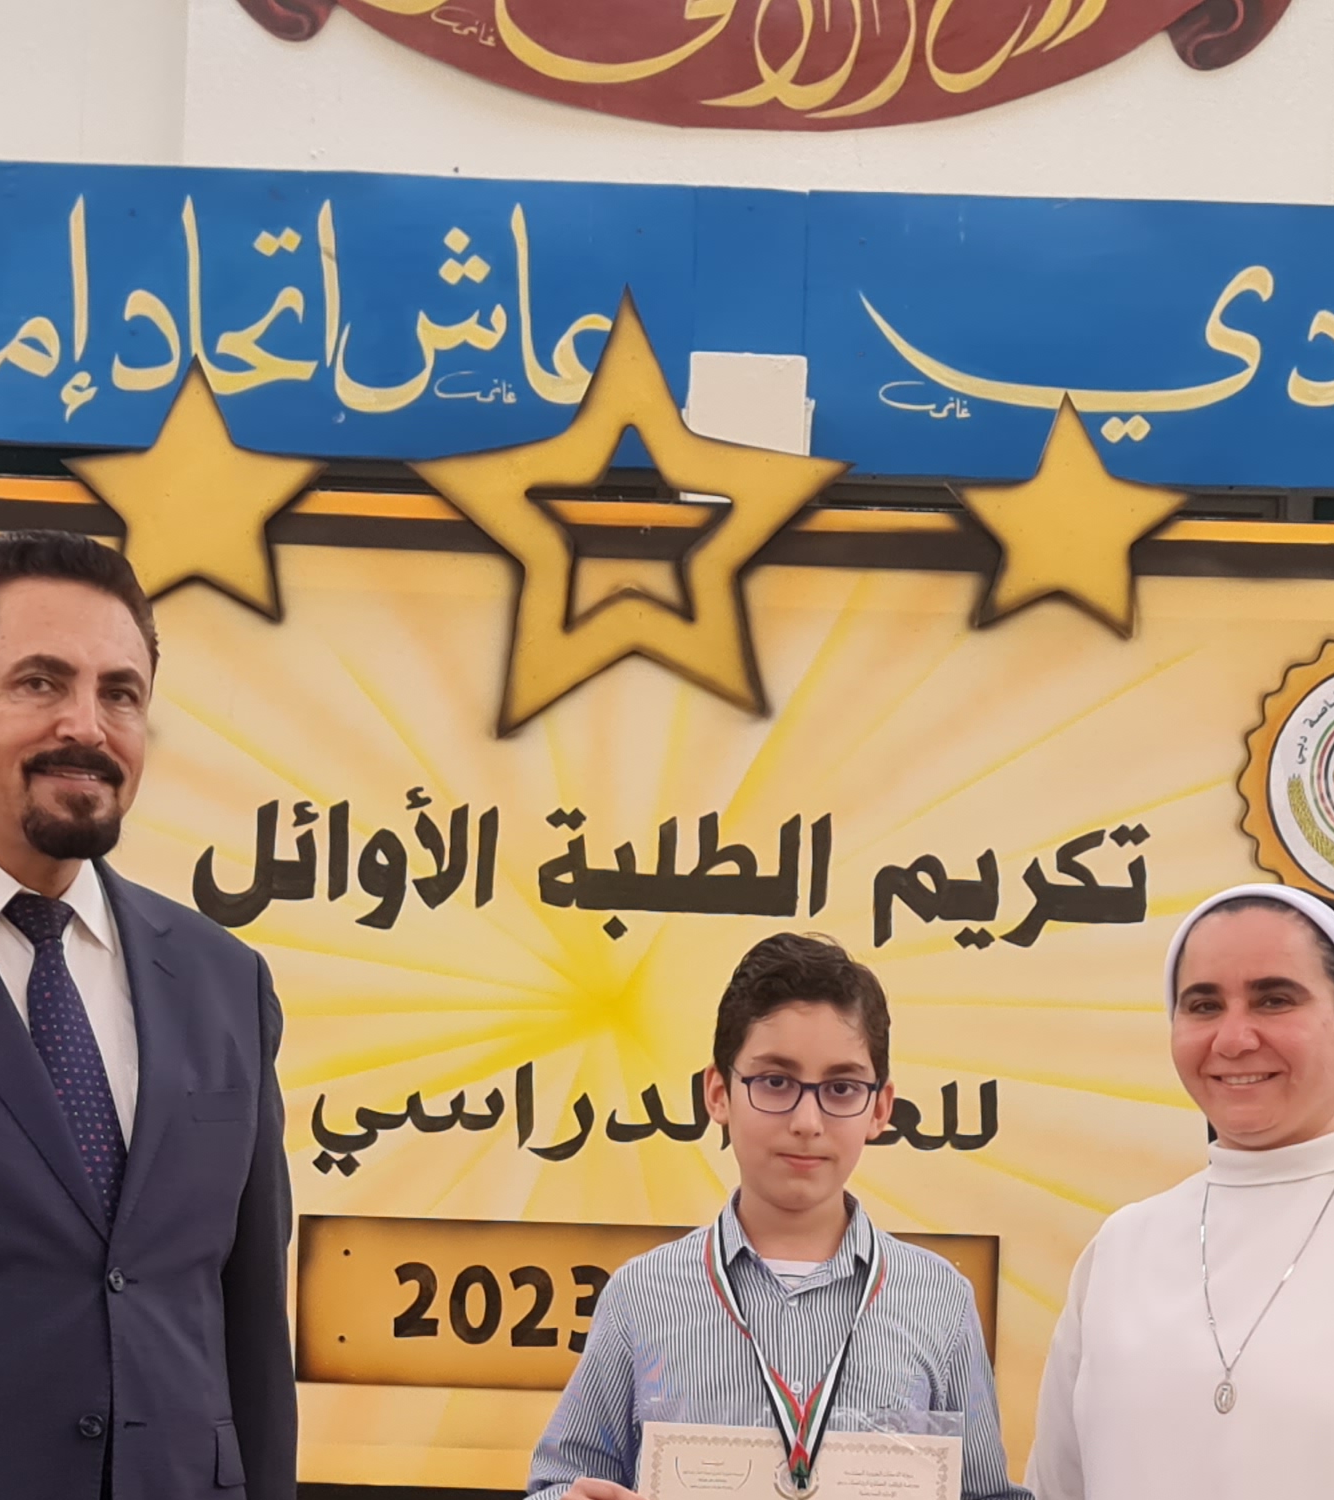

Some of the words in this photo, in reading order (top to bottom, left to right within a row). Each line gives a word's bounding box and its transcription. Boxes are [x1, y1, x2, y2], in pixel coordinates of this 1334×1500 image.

[112, 193, 340, 397] اتحاد
[334, 202, 614, 413] عاش
[1295, 735, 1309, 765] دبي
[191, 786, 500, 929] الأوائل
[537, 809, 834, 941] الطلبة
[872, 822, 1151, 949] تكريم
[311, 1060, 732, 1177] لدراسي
[864, 1079, 999, 1151] للع
